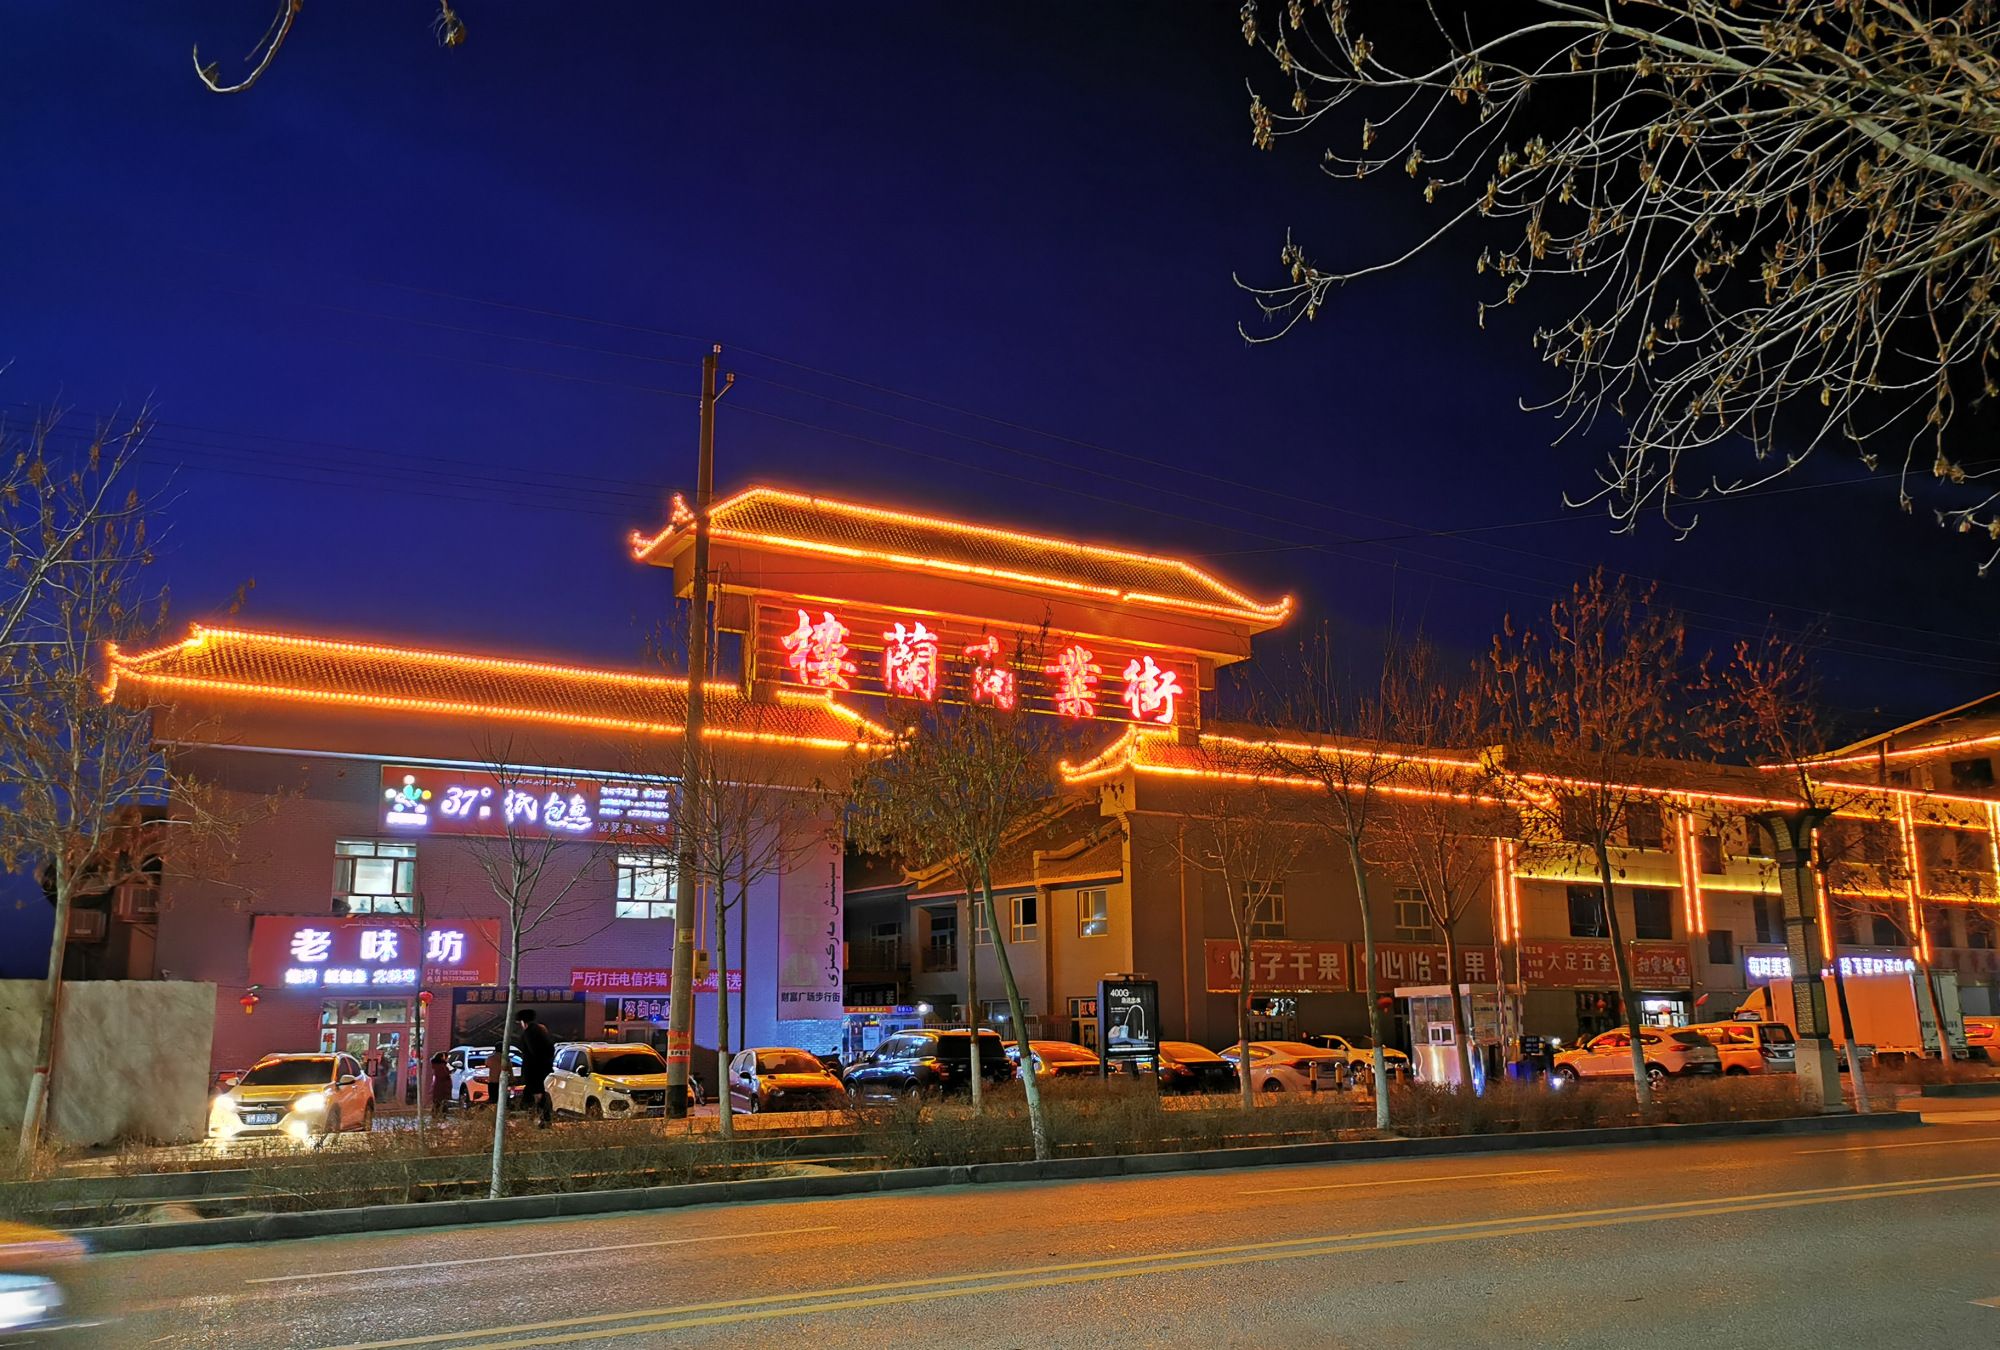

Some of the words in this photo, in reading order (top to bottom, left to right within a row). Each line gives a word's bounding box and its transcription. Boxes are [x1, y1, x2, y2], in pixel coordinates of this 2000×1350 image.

[290, 928, 464, 962] 老味坊
[1548, 952, 1612, 973] 大足五金
[780, 991, 840, 1003] 财富广场步行街
